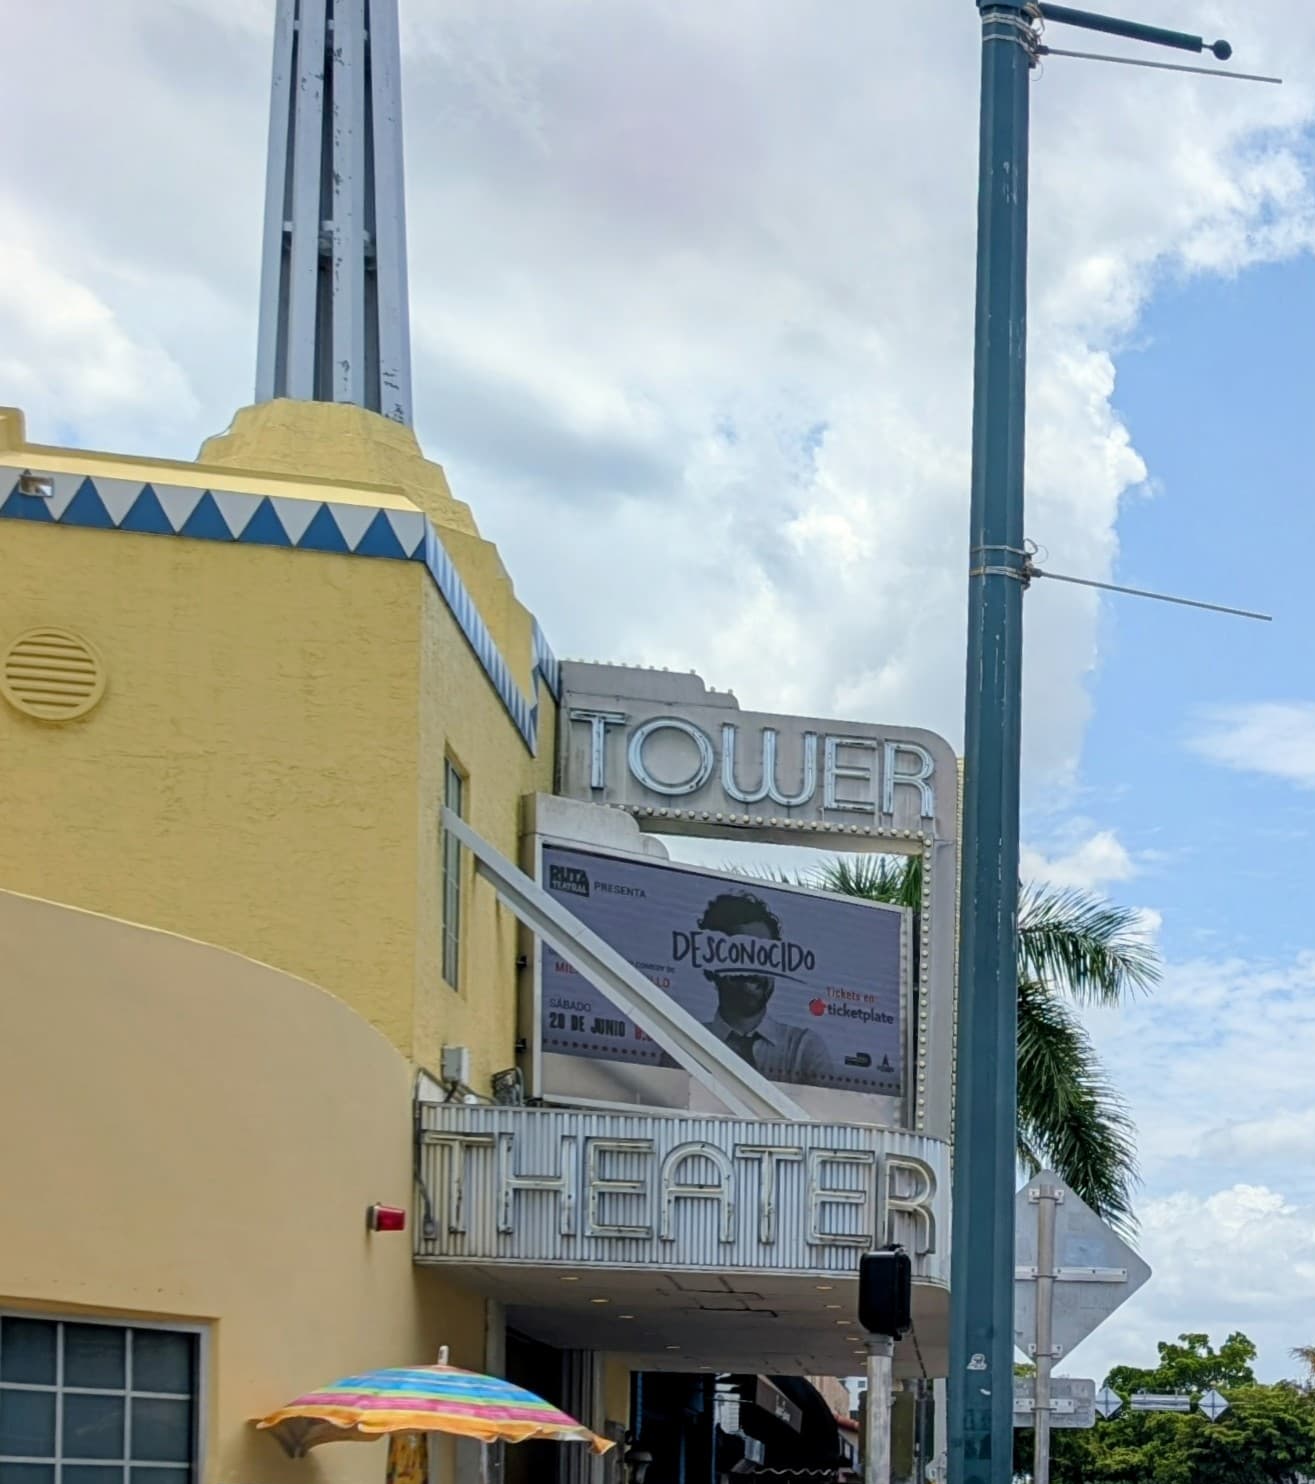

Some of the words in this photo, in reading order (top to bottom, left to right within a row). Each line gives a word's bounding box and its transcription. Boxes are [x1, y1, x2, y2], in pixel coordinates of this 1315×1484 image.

[569, 708, 937, 818] TOWER
[594, 881, 647, 898] PRESENTA
[672, 930, 816, 972] DESCONOCIDO
[826, 985, 861, 1001] Tickets
[571, 1014, 585, 1032] DE
[590, 1017, 626, 1038] JUNIO
[827, 1004, 895, 1024] ticketplate
[422, 1131, 937, 1255] THEATER
